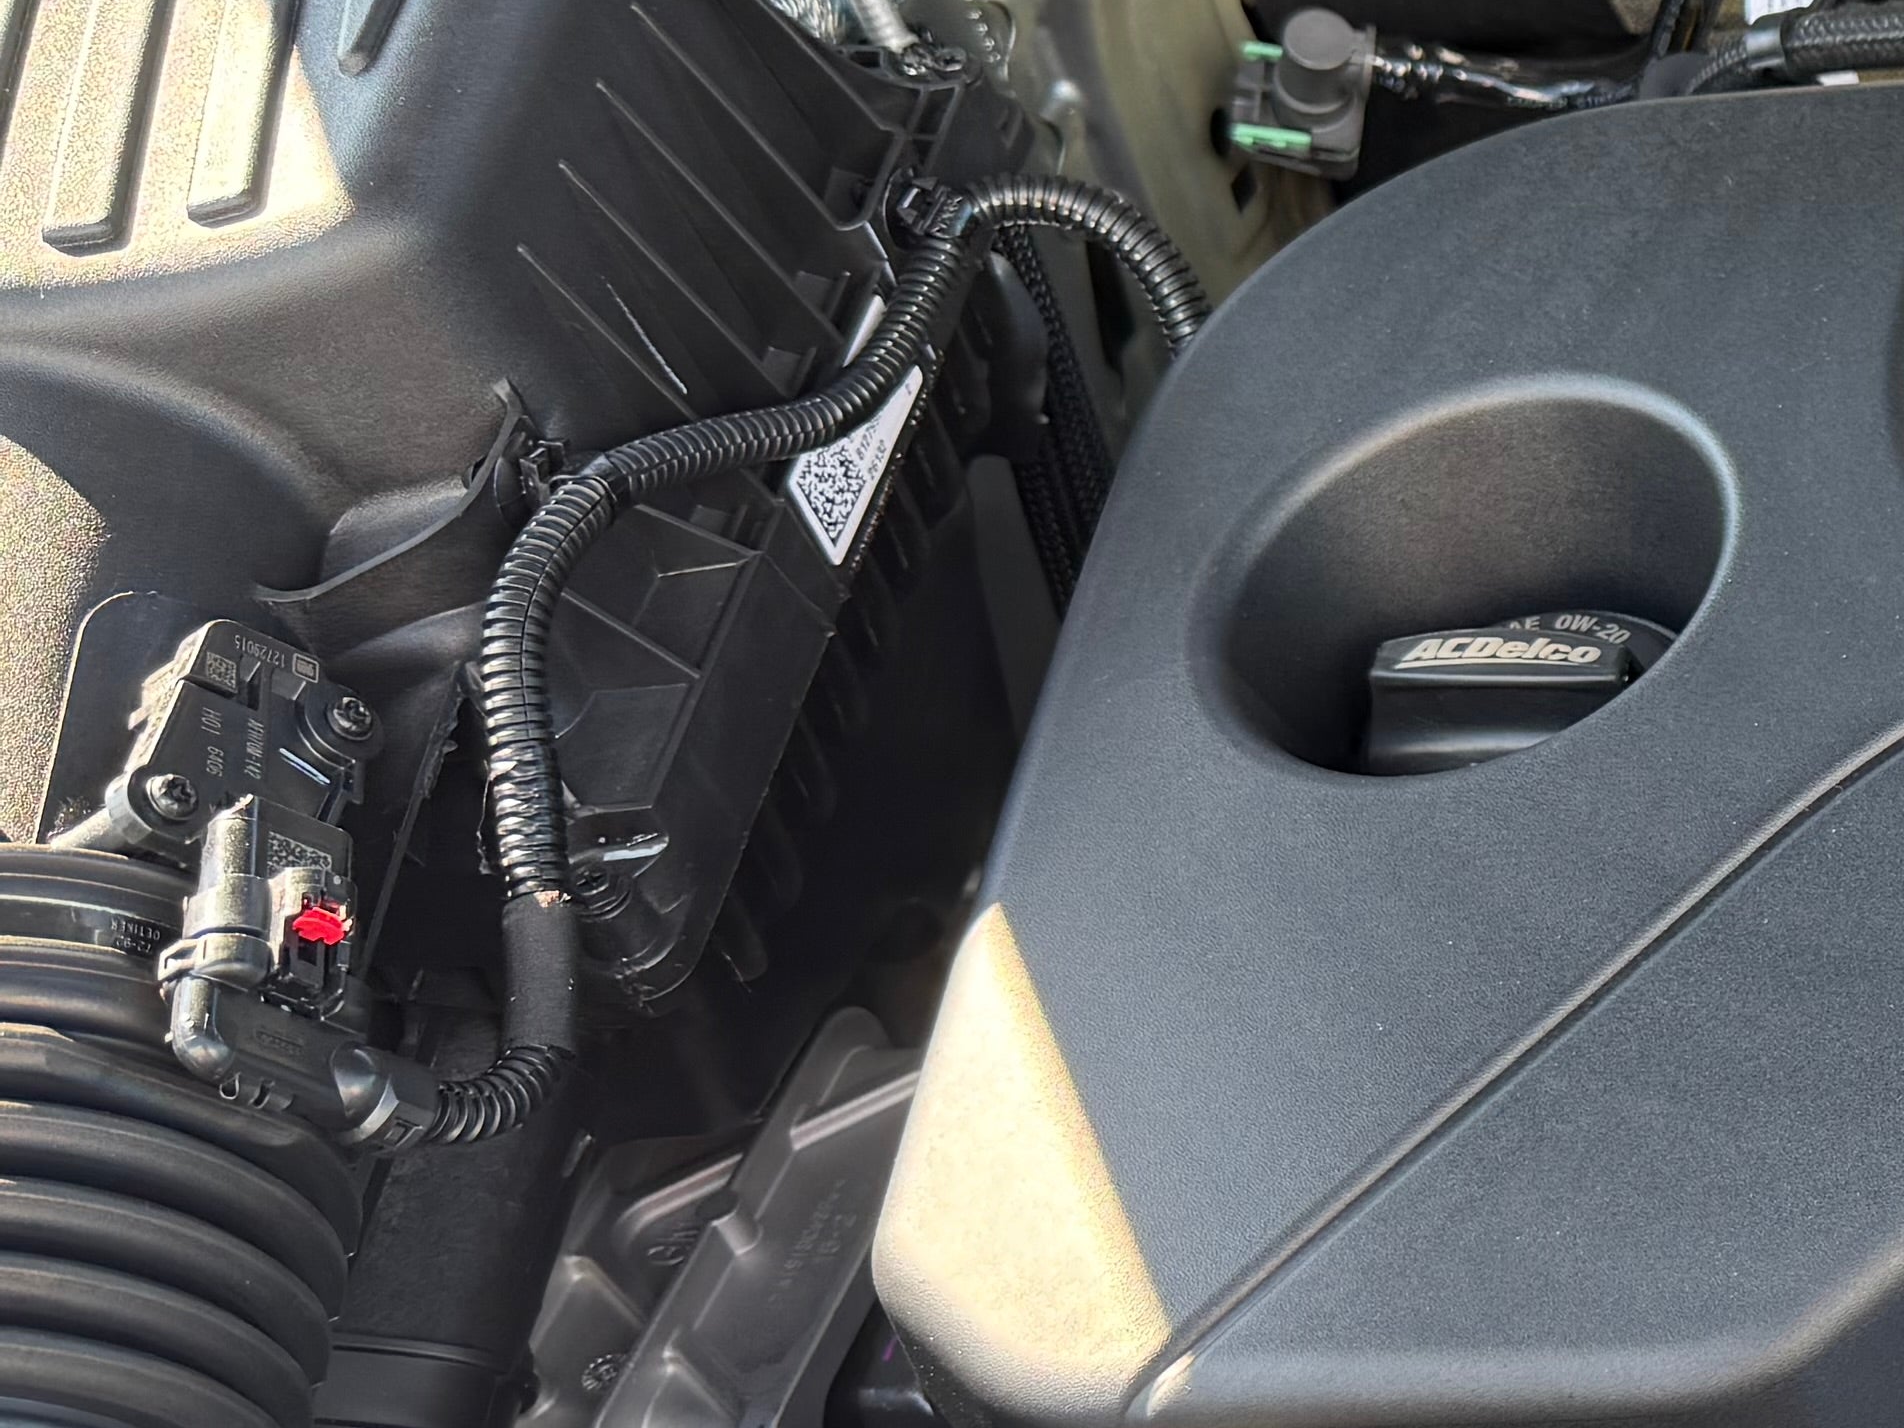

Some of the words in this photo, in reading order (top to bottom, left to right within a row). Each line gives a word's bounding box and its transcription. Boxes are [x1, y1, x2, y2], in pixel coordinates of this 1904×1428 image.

[1554, 613, 1632, 646] 0W-20
[234, 634, 285, 669] 12729015
[1402, 635, 1602, 664] ACDelco
